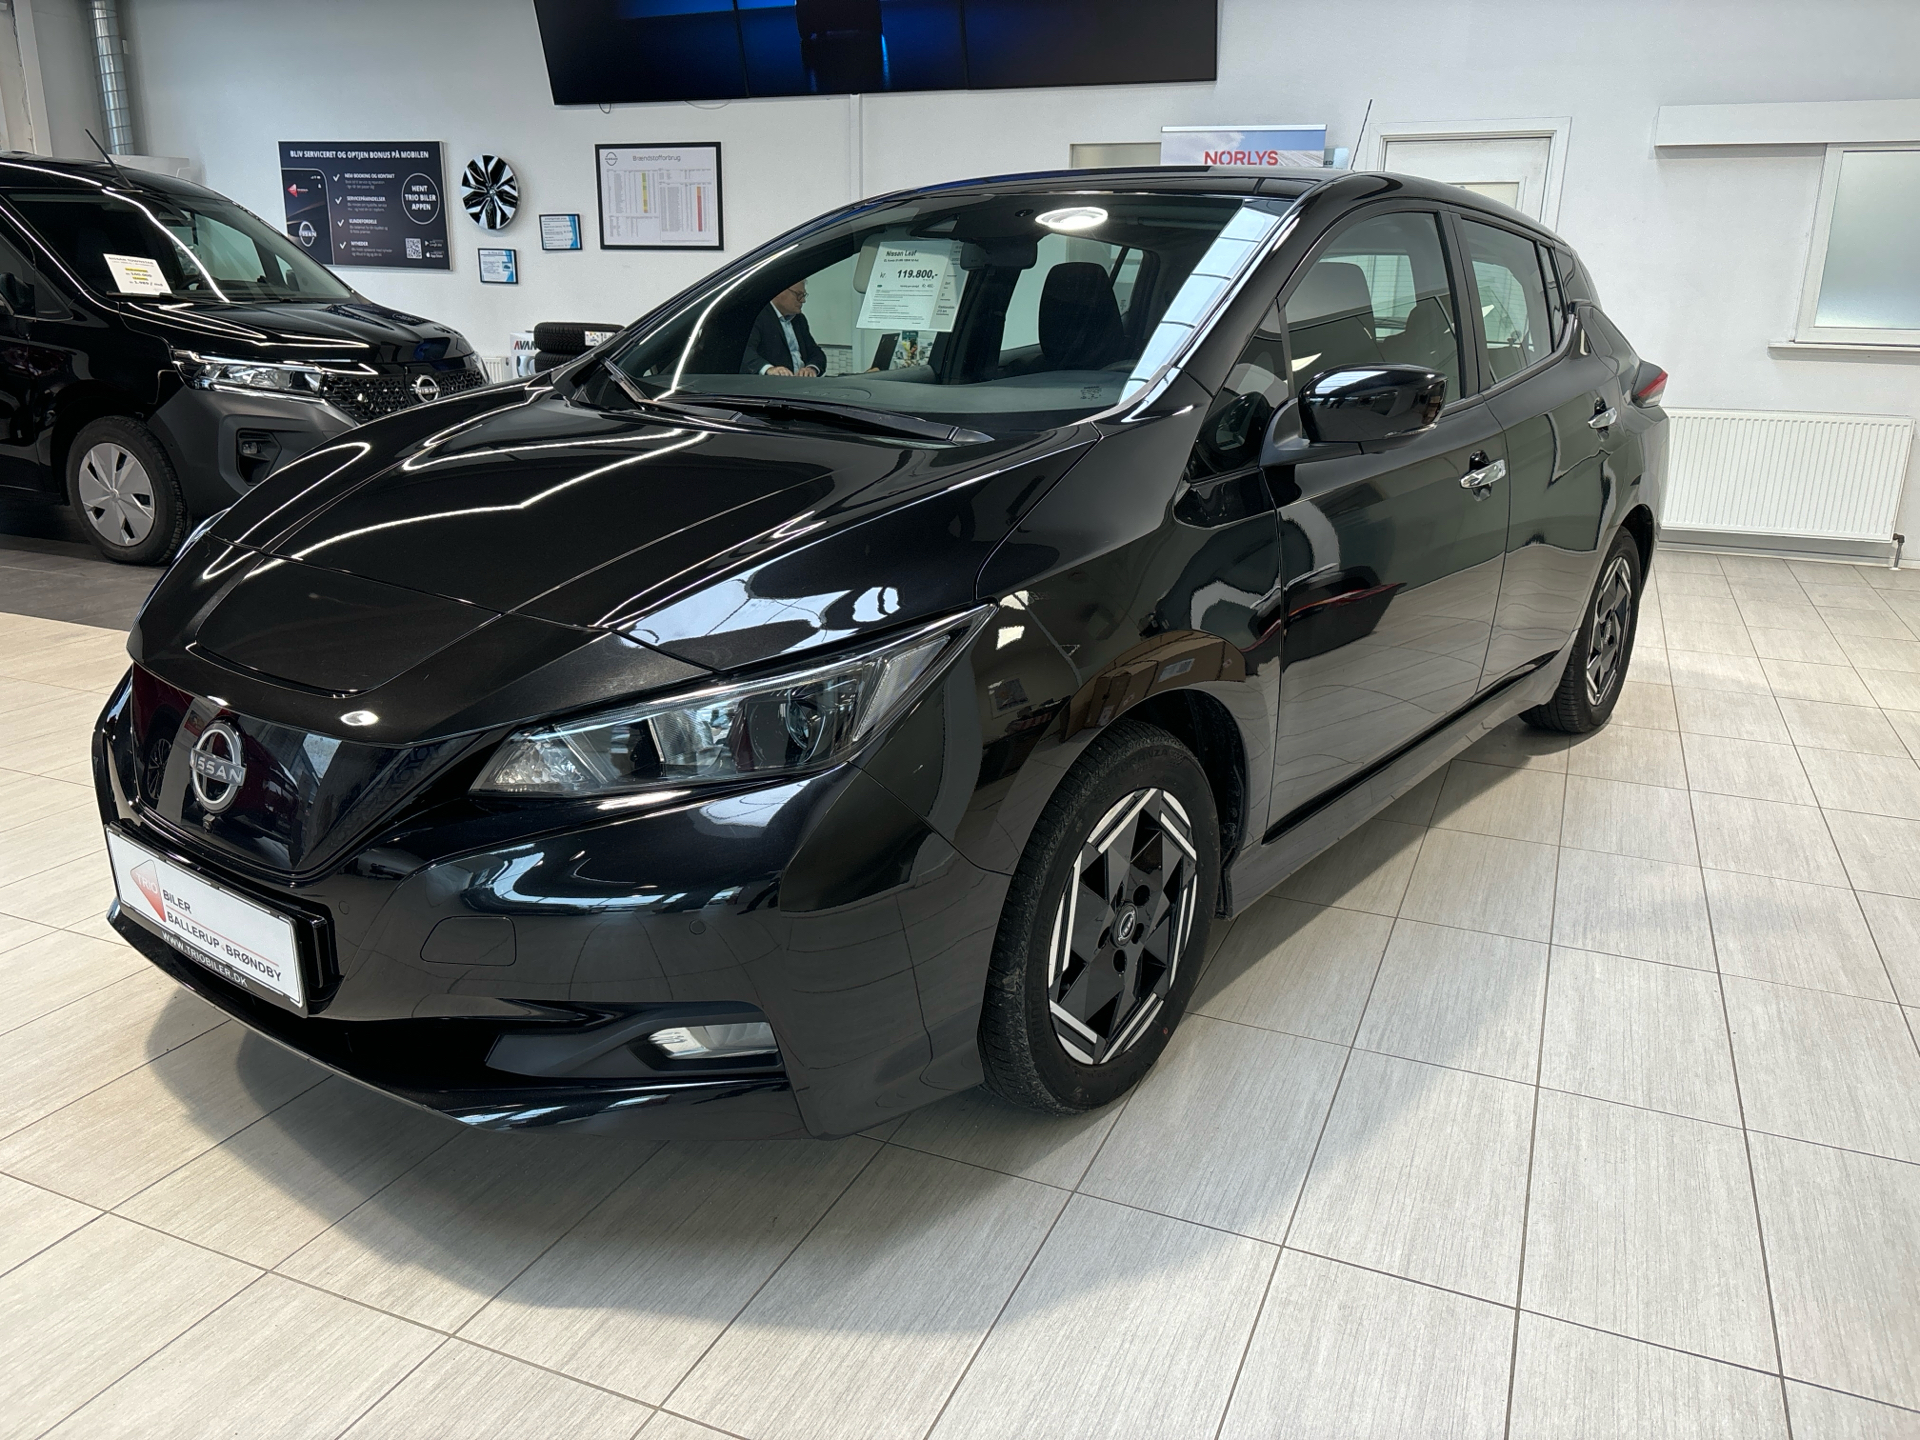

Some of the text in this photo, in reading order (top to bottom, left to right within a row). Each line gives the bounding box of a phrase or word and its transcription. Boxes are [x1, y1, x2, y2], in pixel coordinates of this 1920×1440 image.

[290, 149, 429, 160] BLIV SERVICERET OG OPTJEN BONUS PÅ MOBILEN
[1204, 150, 1279, 166] NORLYS
[904, 249, 917, 257] Leaf
[897, 269, 938, 280] 119.800,-
[514, 340, 538, 351] AVAN
[135, 873, 158, 896] TRIO
[162, 889, 193, 915] BILER
[166, 910, 282, 983] BALLERUP BRØNDBY
[161, 930, 248, 988] WWW.TRIOBILER.DK
